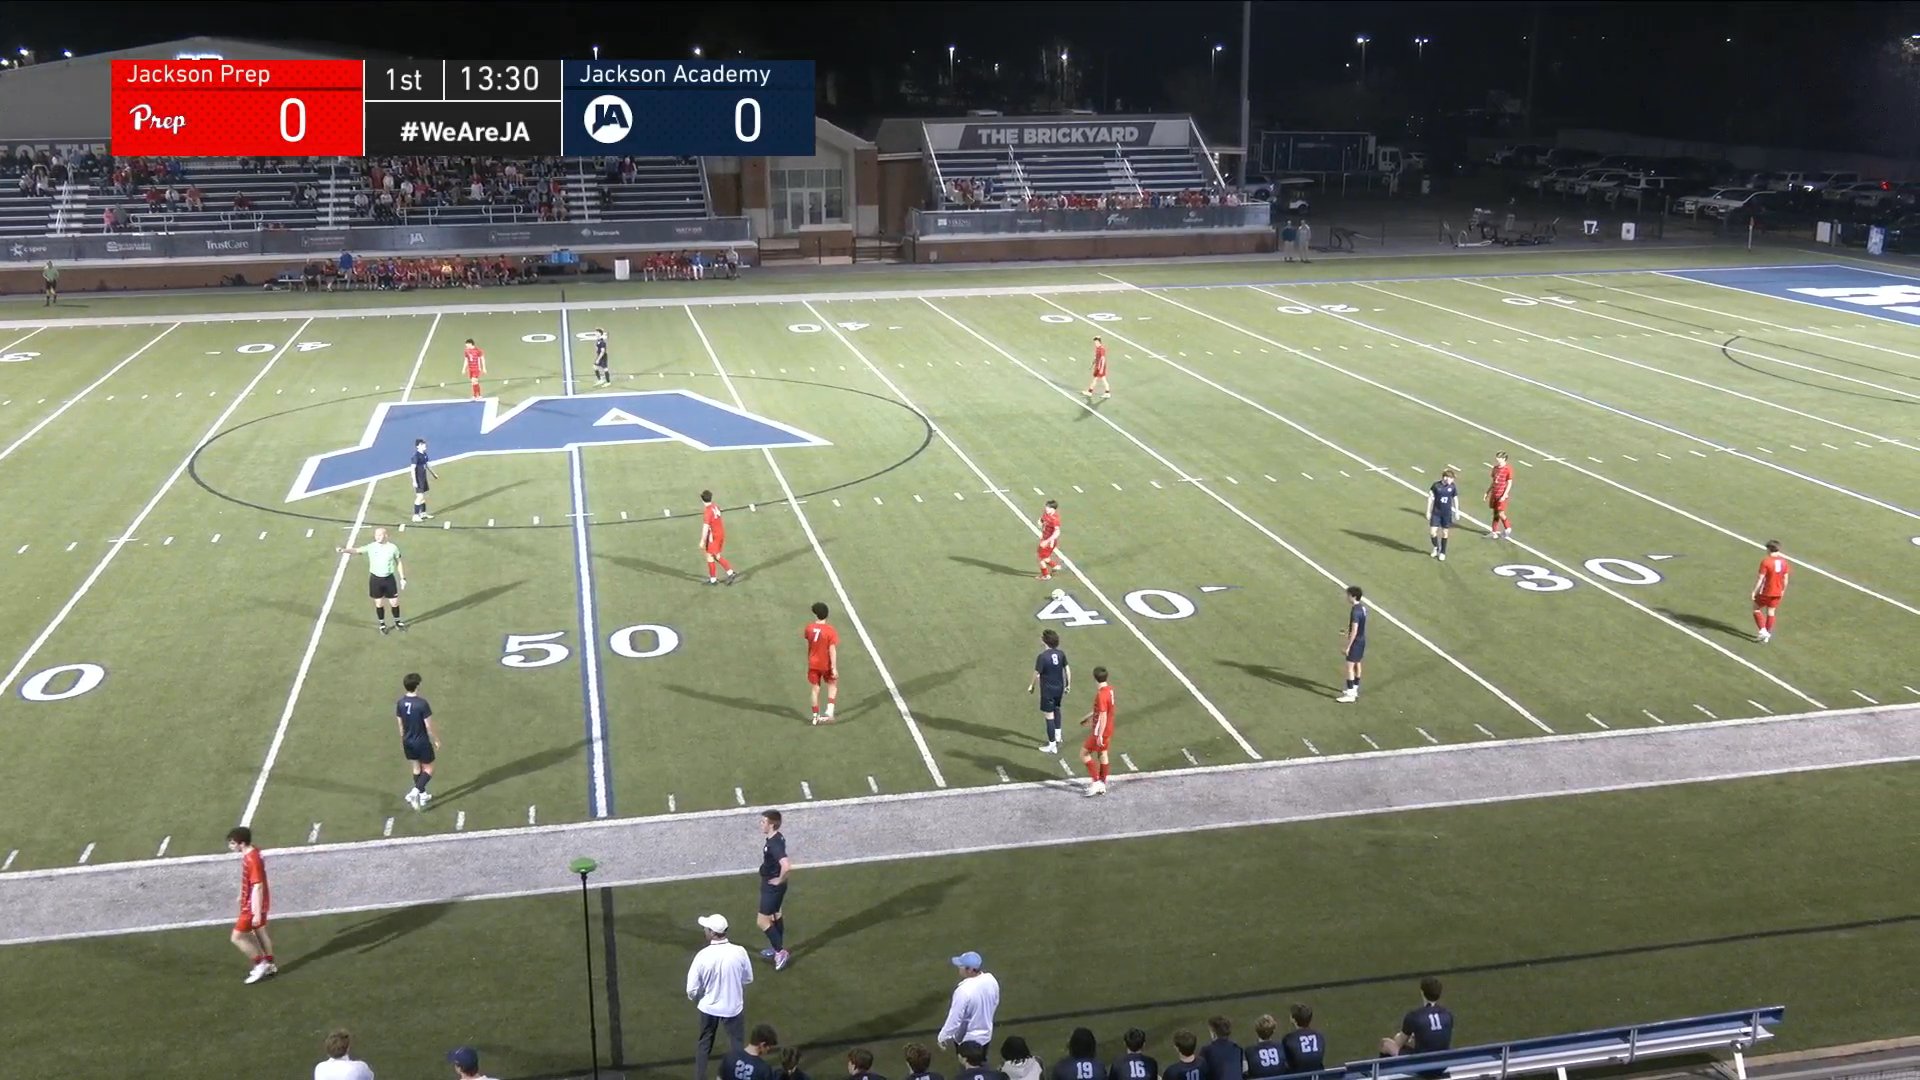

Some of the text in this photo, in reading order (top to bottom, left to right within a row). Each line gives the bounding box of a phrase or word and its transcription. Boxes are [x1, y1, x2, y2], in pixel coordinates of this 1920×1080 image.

[977, 126, 1139, 145] THE BRICKYARD
[206, 240, 249, 250] TrustCare
[812, 627, 822, 643] 7
[404, 701, 412, 715] 7
[1428, 1013, 1443, 1031] 11
[1299, 1034, 1319, 1053] 27
[1259, 1048, 1281, 1067] 99
[734, 1059, 755, 1080] 22
[1076, 1061, 1094, 1080] 19
[1128, 1060, 1147, 1079] 16
